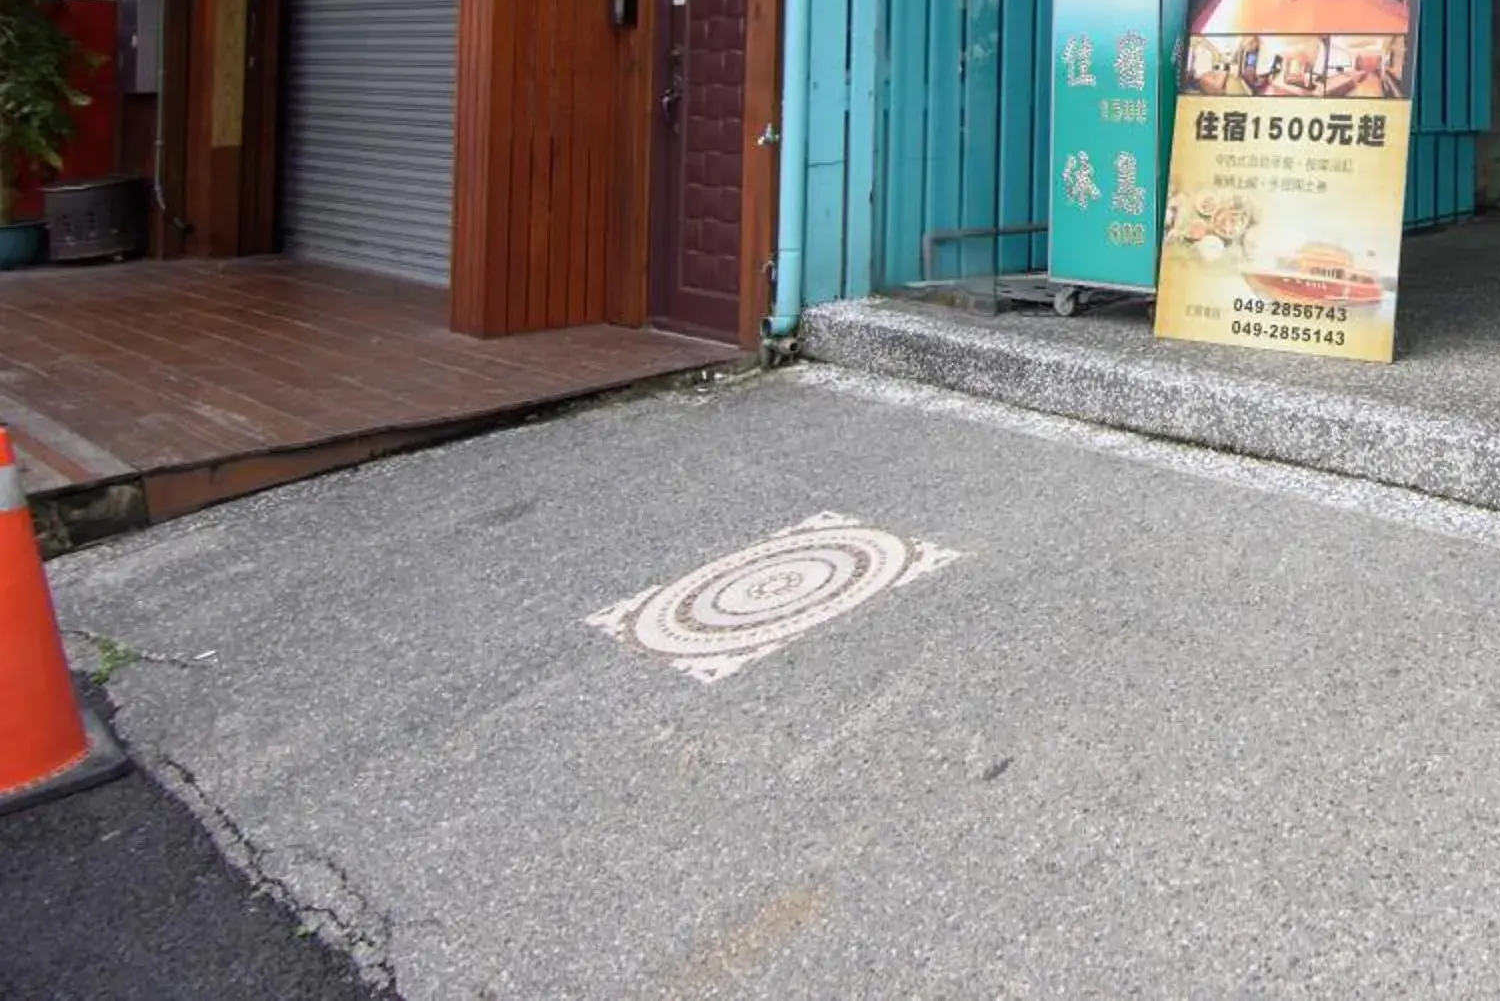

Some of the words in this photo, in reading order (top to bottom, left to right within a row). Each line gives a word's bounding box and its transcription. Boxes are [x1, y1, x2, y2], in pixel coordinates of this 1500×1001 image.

[1195, 111, 1386, 146] 住宿1500元起
[1231, 320, 1345, 346] 049-2855143
